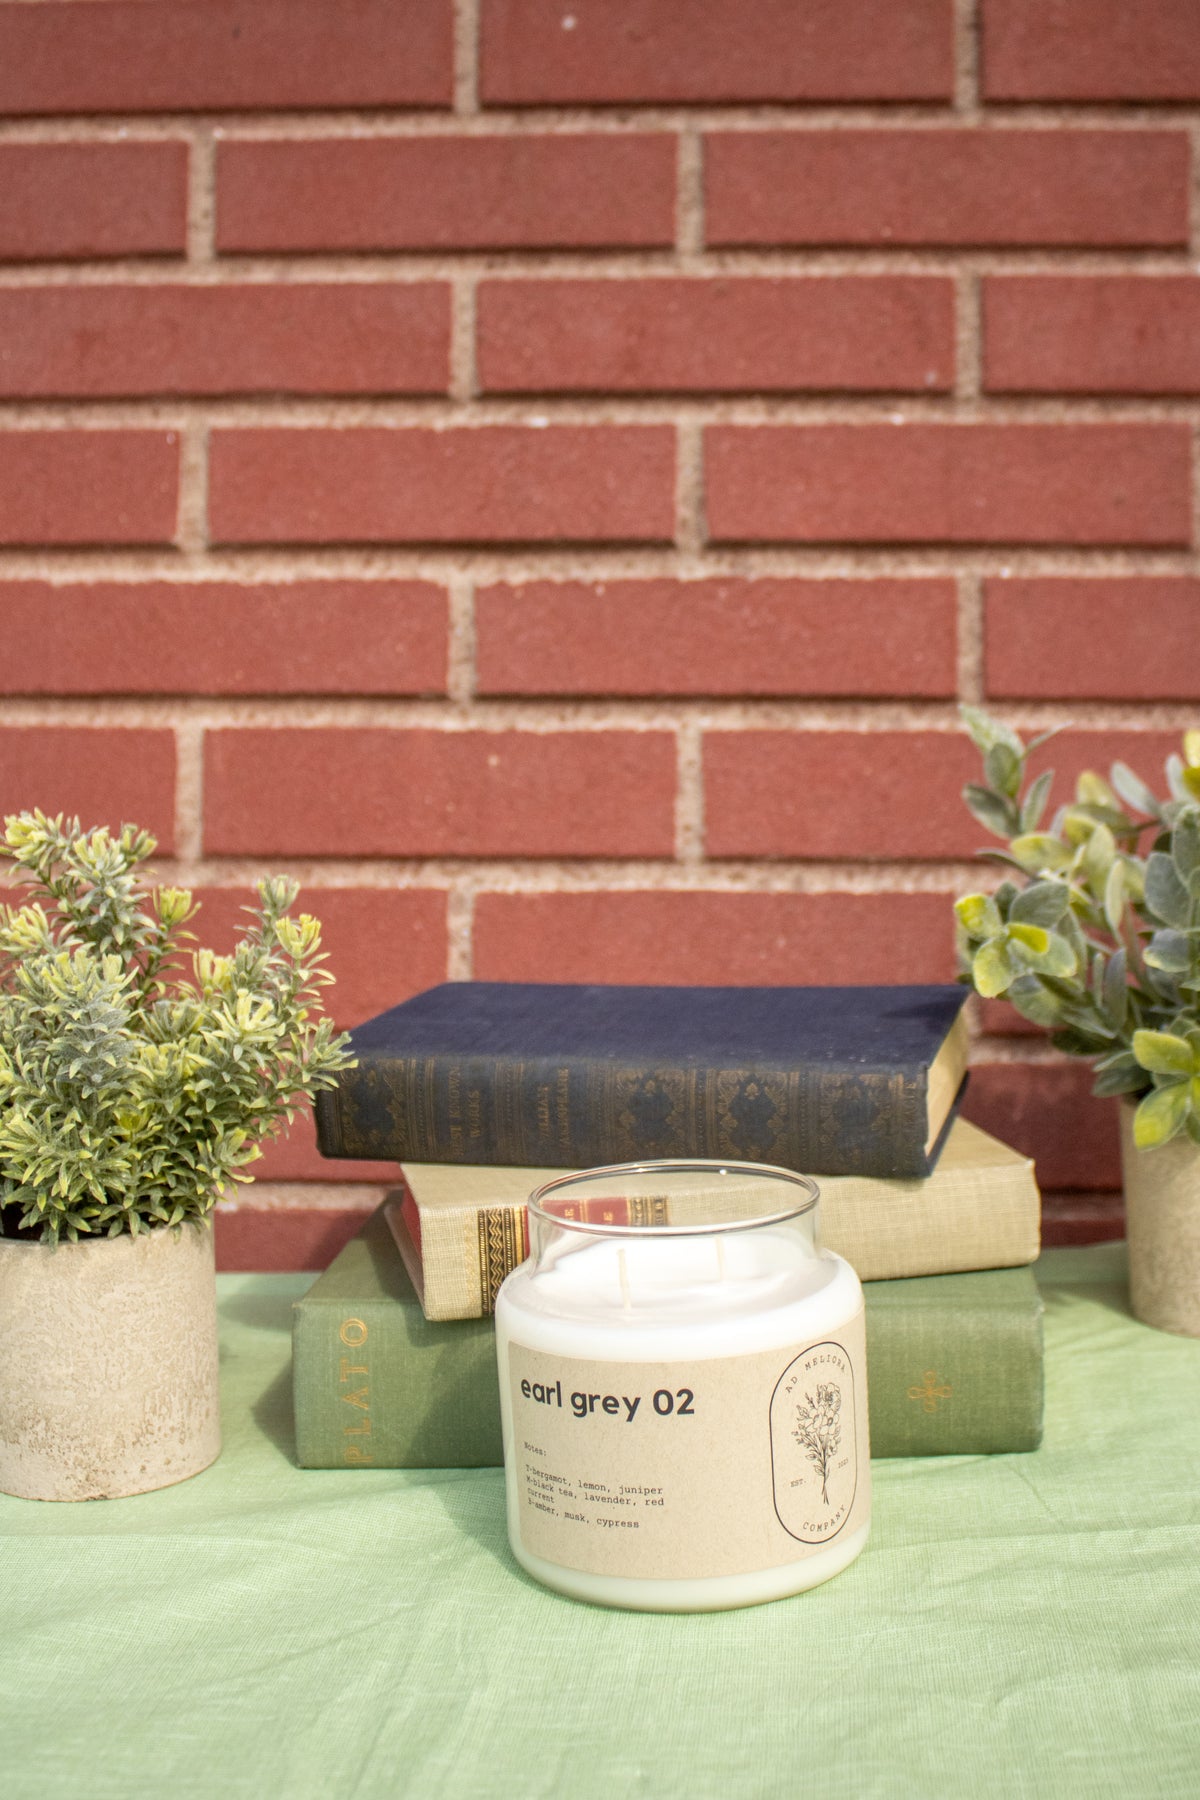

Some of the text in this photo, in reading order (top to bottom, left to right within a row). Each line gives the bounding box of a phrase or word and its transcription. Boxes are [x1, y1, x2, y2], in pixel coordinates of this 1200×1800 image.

[467, 1089, 481, 1139] WORKS
[557, 1068, 570, 1157] HAKESPEARE
[785, 1354, 846, 1393] AD MELIORA
[339, 1317, 373, 1463] PLATO
[521, 1378, 695, 1422] earl grey 02
[523, 1441, 547, 1457] Notes:
[525, 1463, 664, 1496] T-bergamot, lemon, juniper
[526, 1475, 665, 1507] M-black tea, lavender, red
[527, 1487, 555, 1504] current
[790, 1478, 807, 1488] EST.
[564, 1511, 590, 1524] musk,
[596, 1517, 640, 1529] cypress
[802, 1504, 846, 1532] COMPANY
